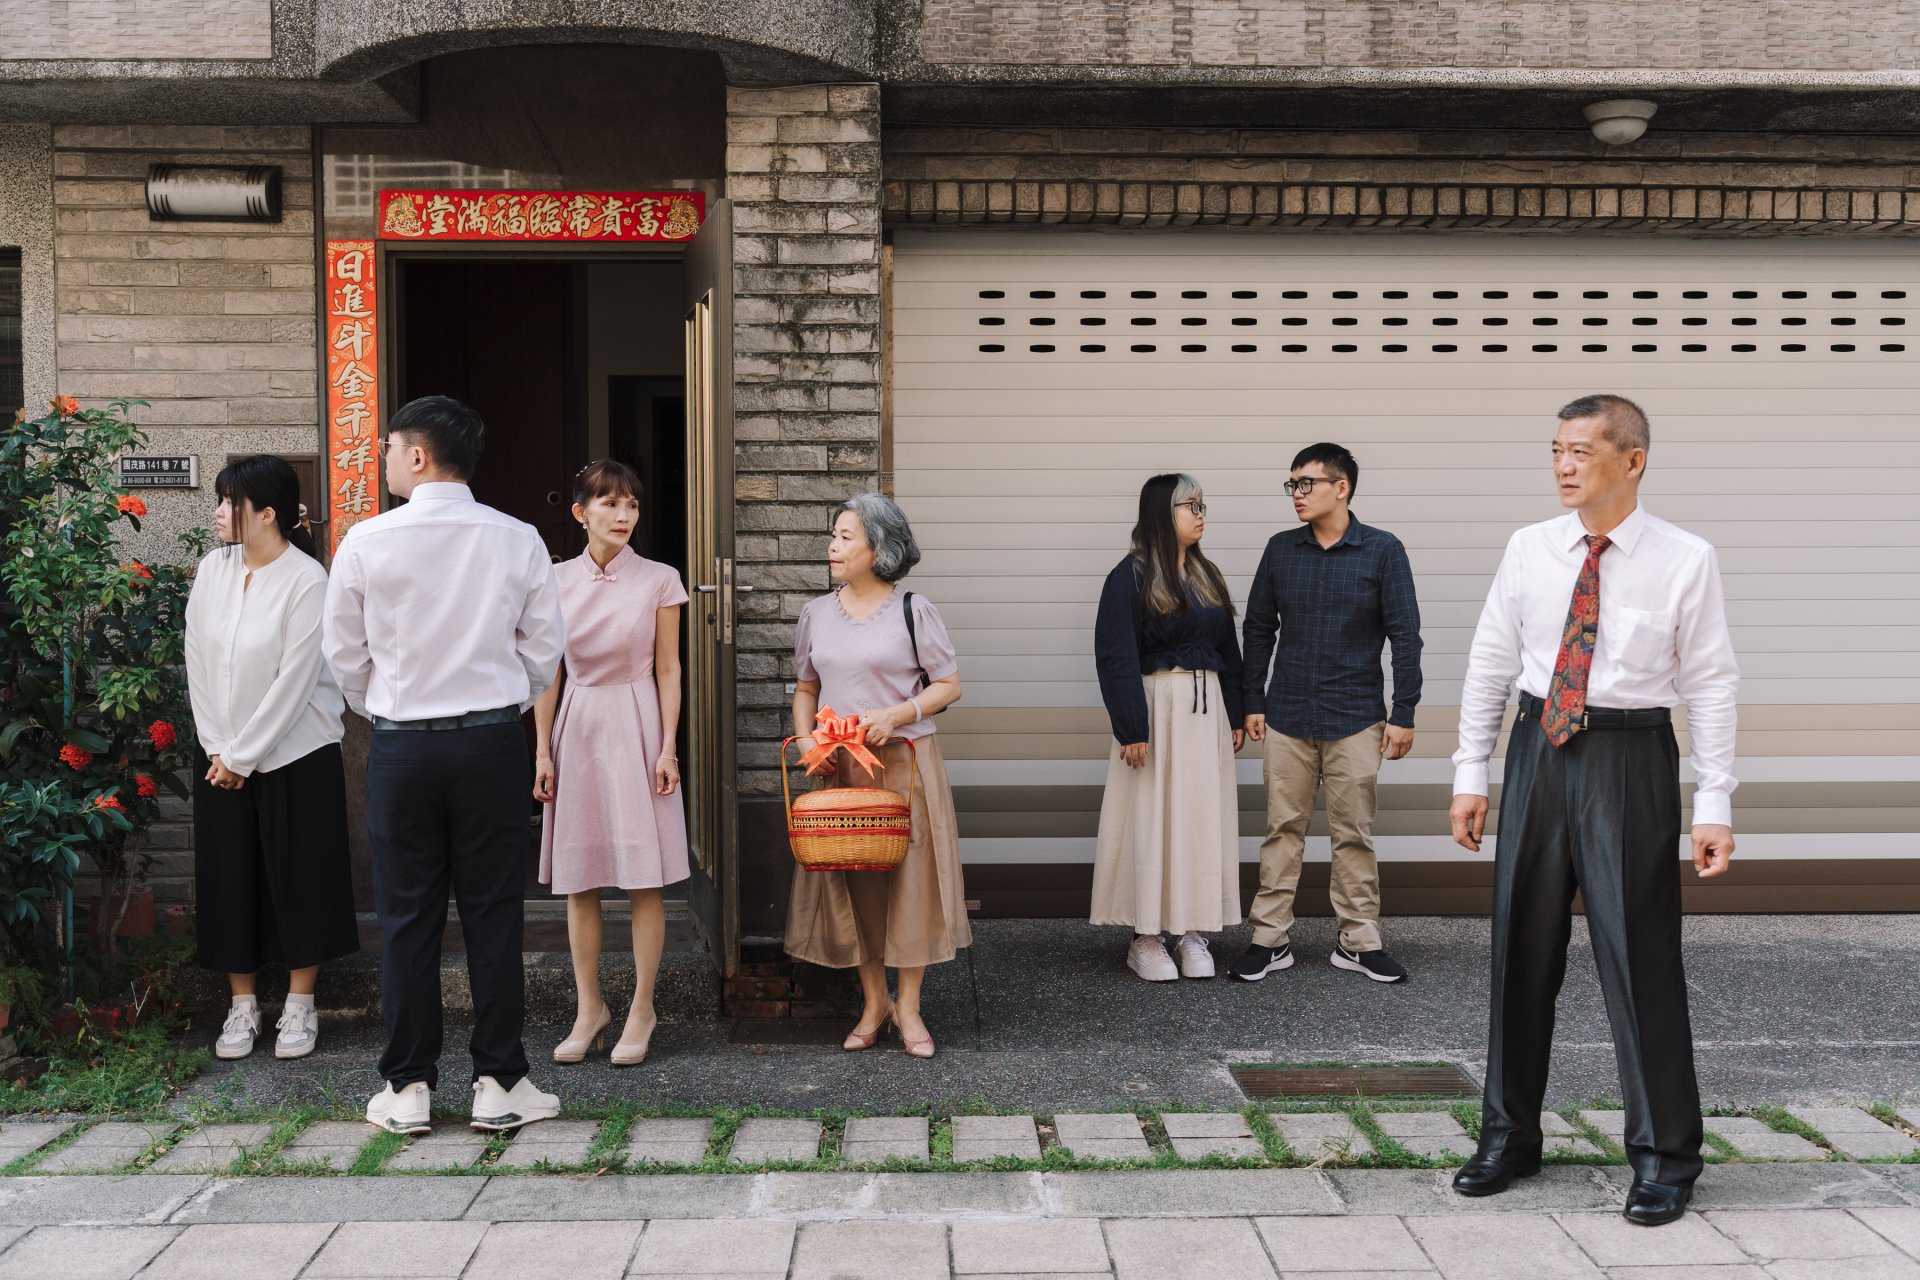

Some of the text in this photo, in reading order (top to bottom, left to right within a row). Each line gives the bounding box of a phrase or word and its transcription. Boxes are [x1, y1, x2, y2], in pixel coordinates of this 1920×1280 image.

[332, 250, 376, 515] 日進斗金千祥集
